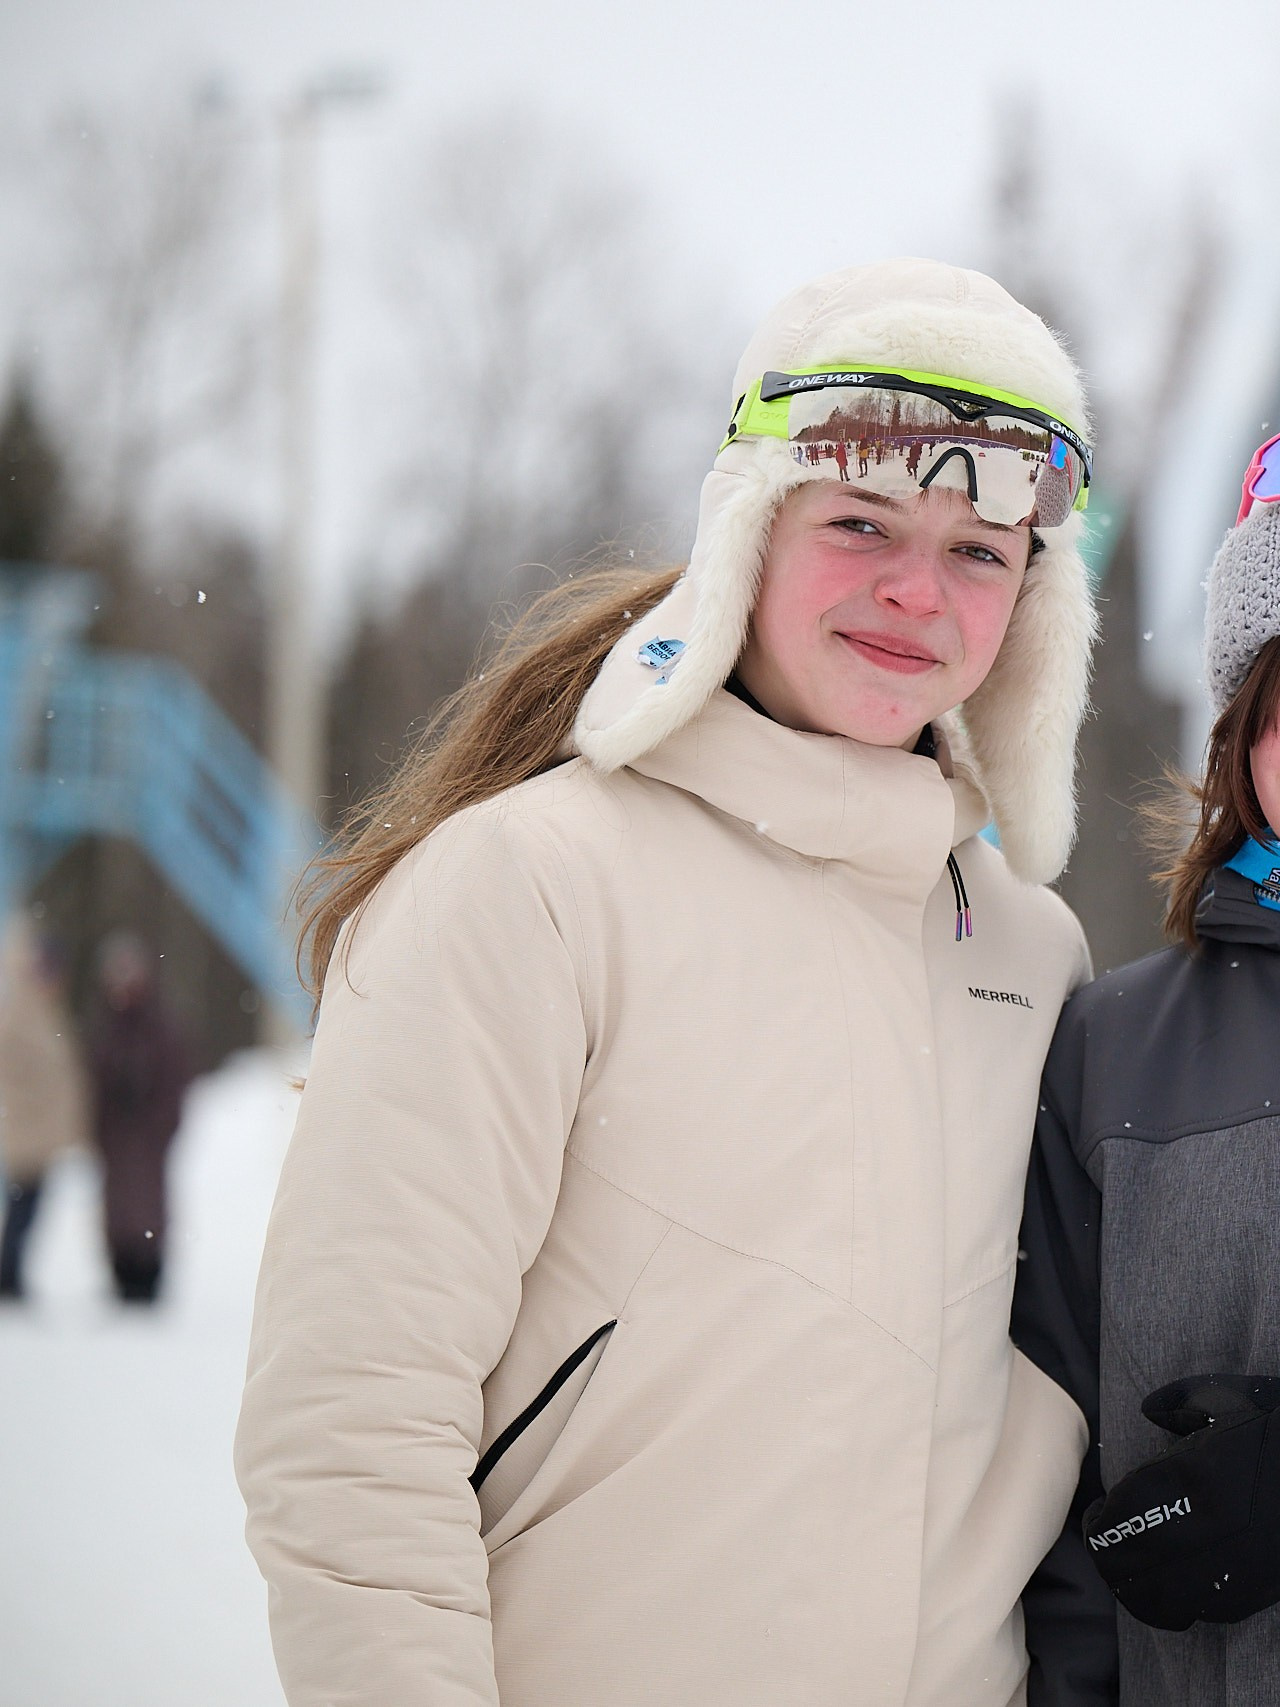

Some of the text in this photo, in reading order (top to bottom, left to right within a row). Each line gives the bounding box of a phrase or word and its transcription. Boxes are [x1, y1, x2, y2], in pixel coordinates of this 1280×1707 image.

[788, 374, 875, 388] ONEWAY
[968, 987, 1034, 1009] MERRELL
[1088, 1496, 1192, 1551] NORDSKI
